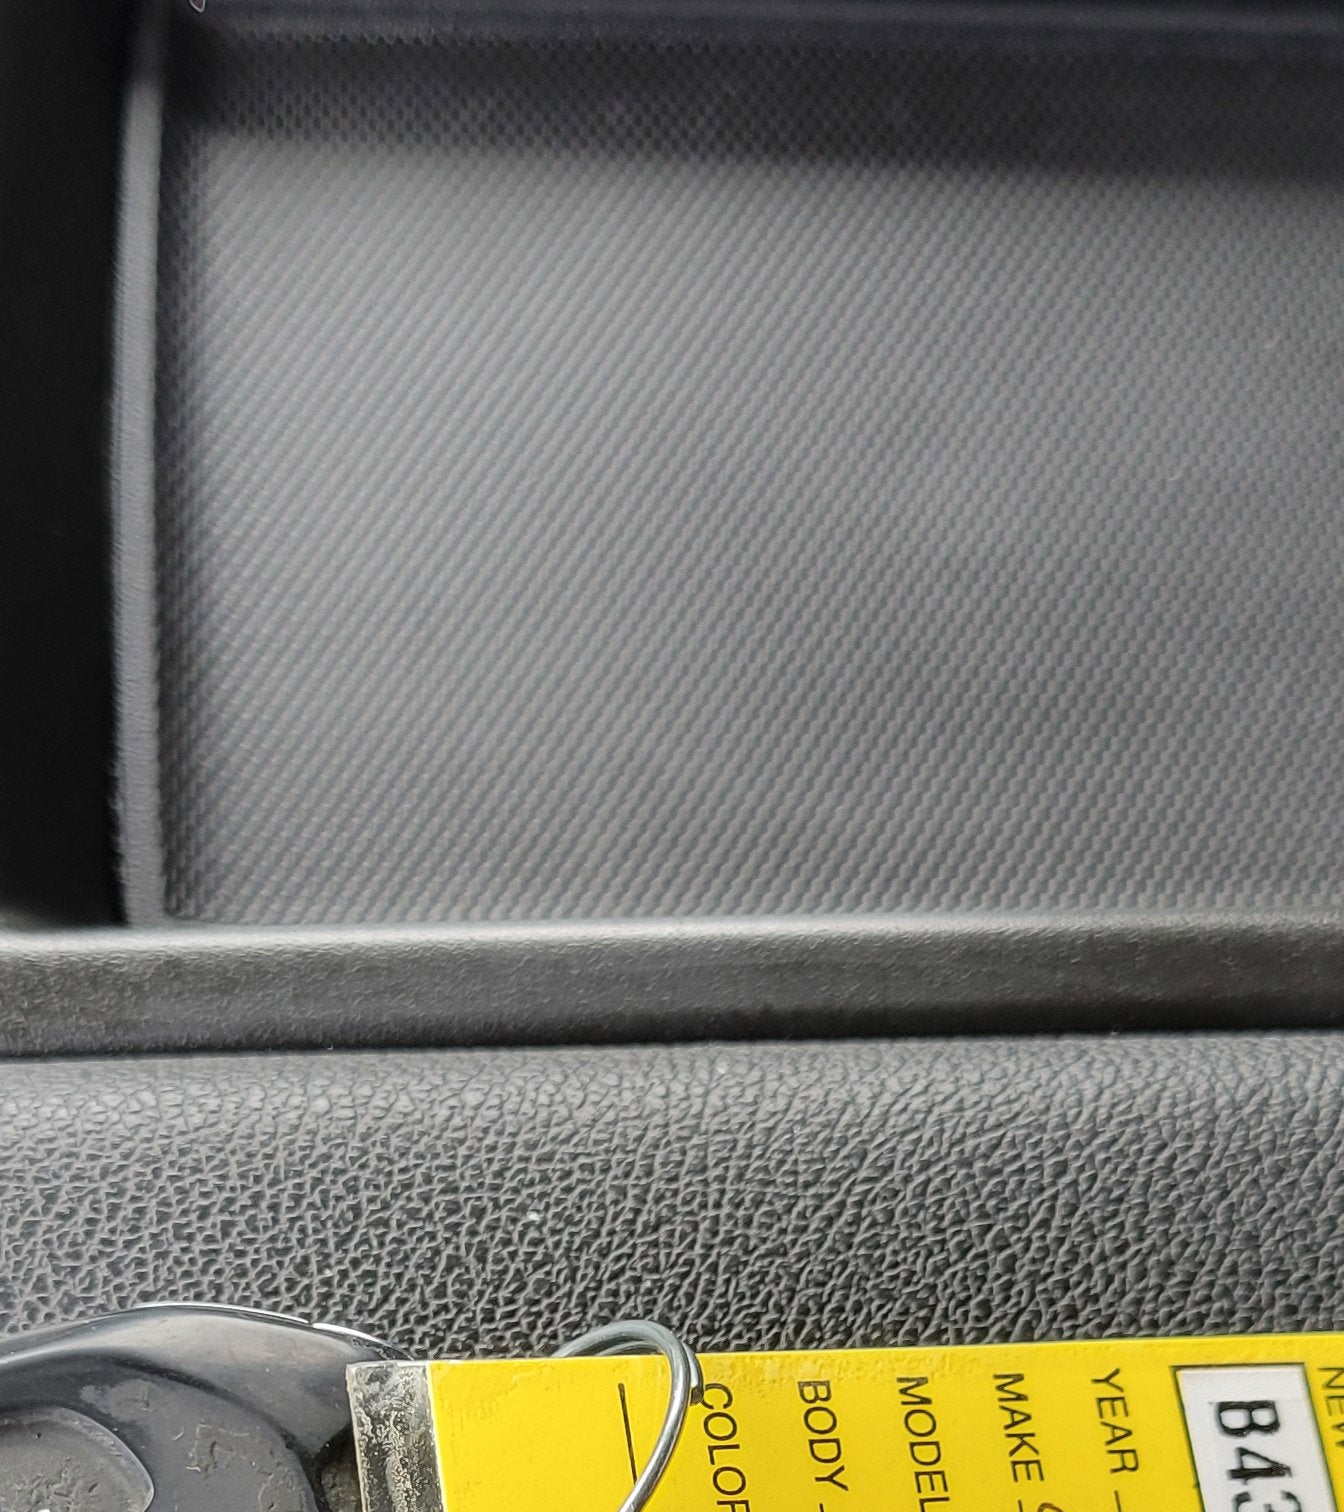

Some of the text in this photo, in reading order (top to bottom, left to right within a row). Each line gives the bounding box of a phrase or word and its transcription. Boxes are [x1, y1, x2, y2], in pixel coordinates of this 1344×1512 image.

[798, 1380, 848, 1492] BODY
[993, 1373, 1045, 1482] MAKE
[1091, 1368, 1139, 1474] YEAR
